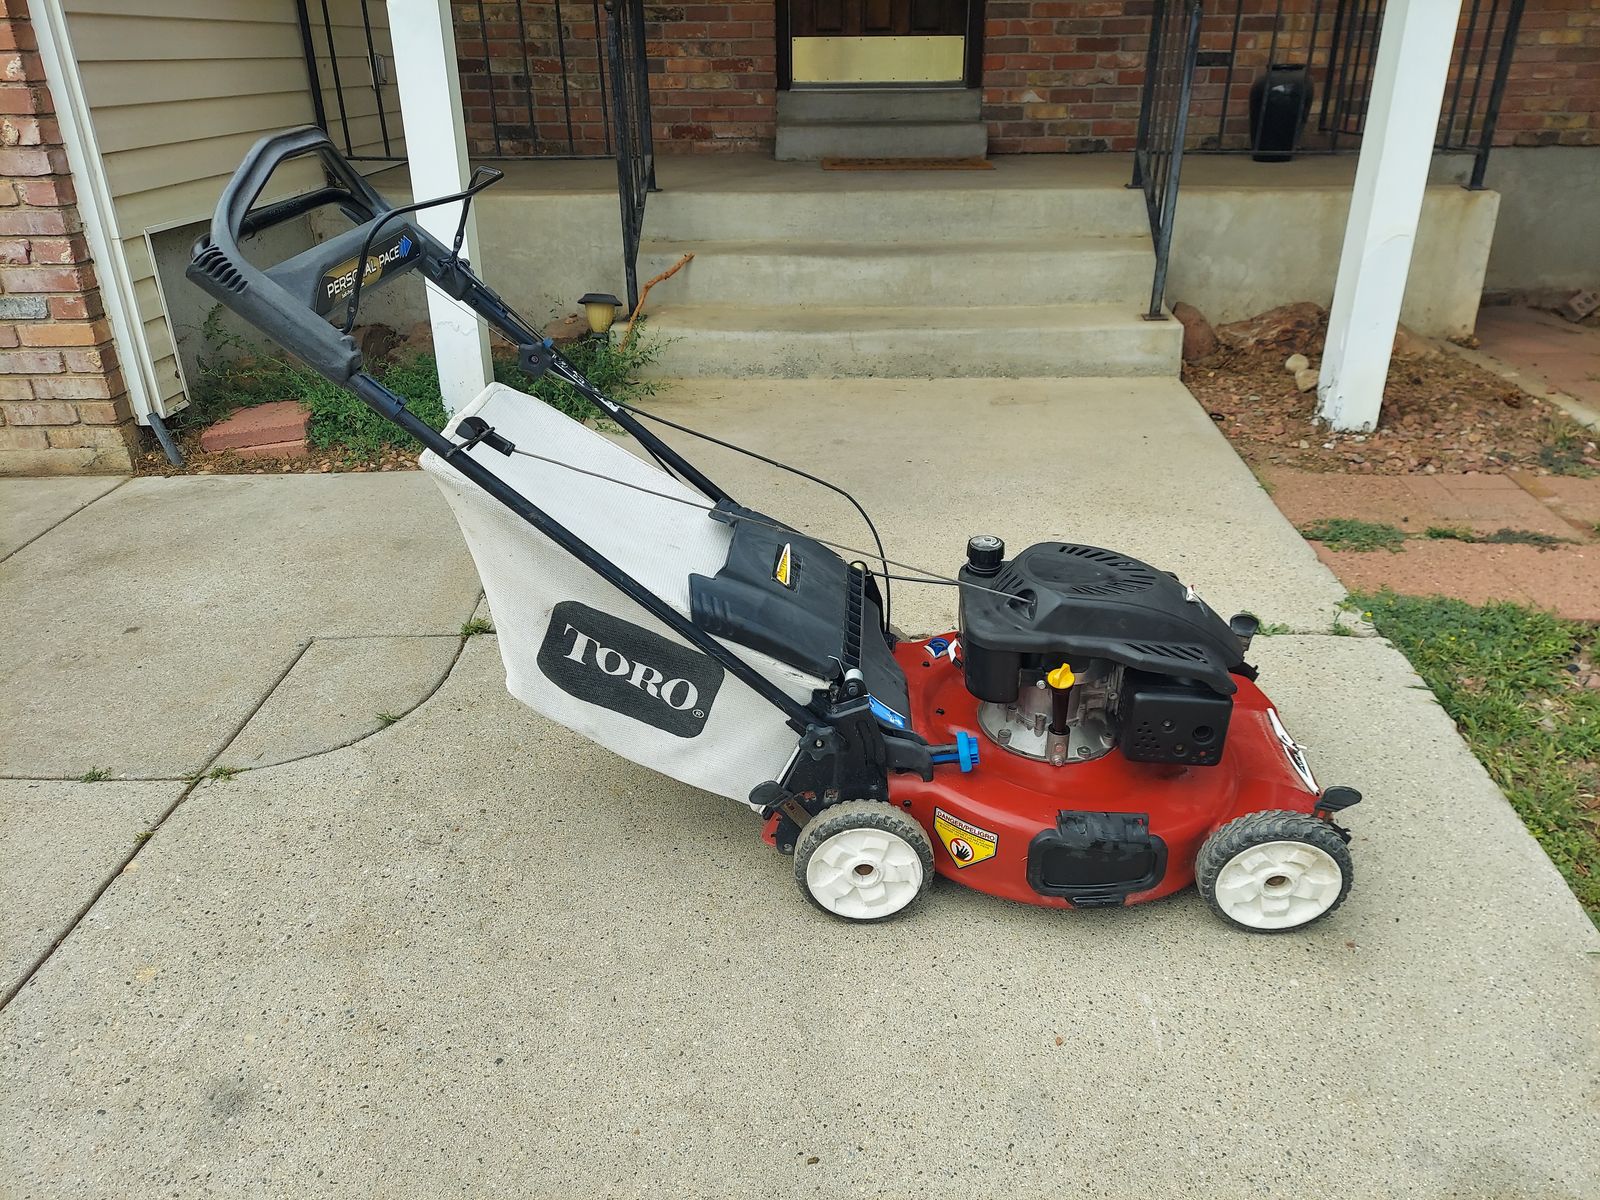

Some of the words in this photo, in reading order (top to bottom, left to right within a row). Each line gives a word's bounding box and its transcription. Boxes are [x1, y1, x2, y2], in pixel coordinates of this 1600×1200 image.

[327, 260, 377, 298] PERSOAL
[378, 245, 400, 267] PACE
[563, 623, 699, 711] TORO
[937, 810, 995, 841] DANGER/PELIGRO
